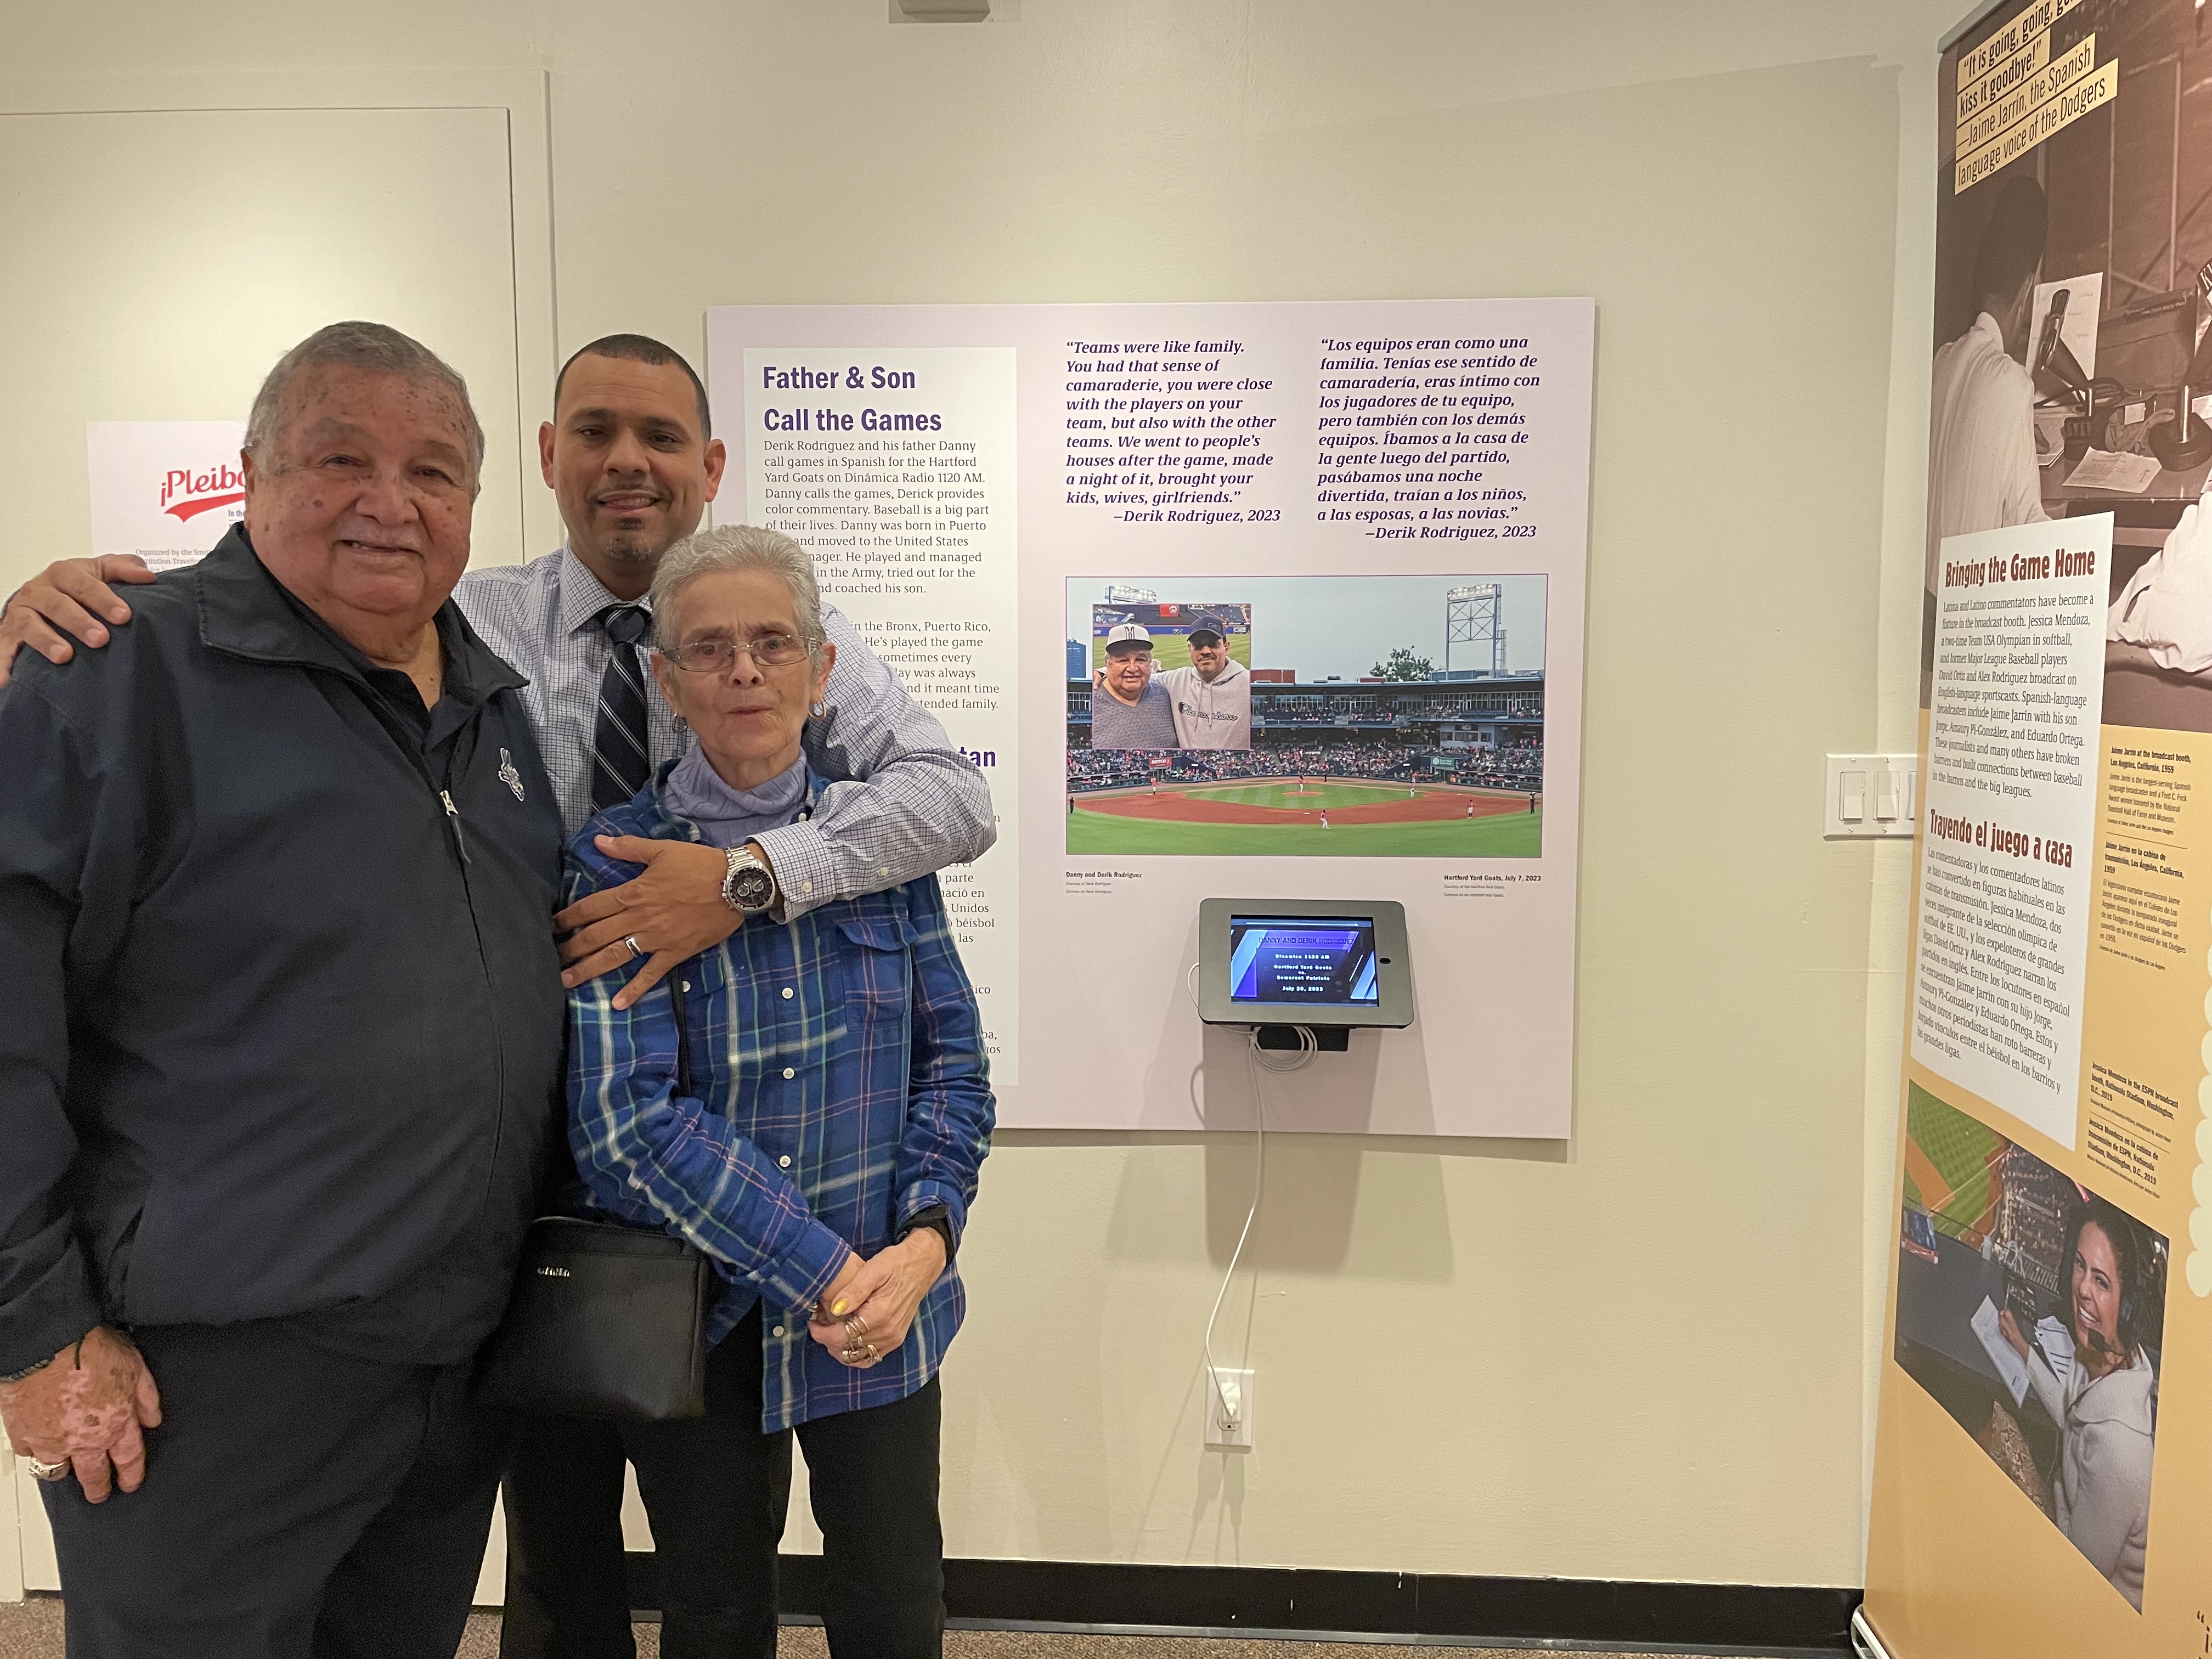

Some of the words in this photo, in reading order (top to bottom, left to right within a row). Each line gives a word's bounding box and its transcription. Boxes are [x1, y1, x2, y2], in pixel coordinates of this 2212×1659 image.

[1965, 55, 1977, 78] “It
[1978, 49, 1985, 70] is
[1989, 27, 2019, 66] going,
[2023, 1, 2053, 43] going,
[1960, 92, 1977, 117] kiss
[1981, 82, 1987, 103] it
[1990, 40, 2041, 101] goodbye!”
[1999, 91, 2027, 128] Jarrín,
[2030, 78, 2045, 105] the
[2049, 43, 2091, 93] Spanish
[1957, 146, 2001, 187] language
[2004, 129, 2026, 158] voice
[2029, 121, 2039, 141] of
[2041, 106, 2057, 133] the
[2061, 77, 2105, 120] Dodgers
[1066, 341, 1120, 353] “Teams
[1123, 343, 1160, 353] were
[1162, 340, 1190, 353] like
[1193, 339, 1244, 356] family.
[1321, 338, 1352, 351] “Los
[1355, 337, 1413, 354] equipos
[1415, 339, 1451, 350] eran
[1454, 338, 1495, 349] como
[1499, 338, 1528, 348] una
[1066, 360, 1092, 373] You
[1095, 359, 1125, 372] had
[1128, 359, 1159, 372] that
[1161, 362, 1201, 372] sense
[1204, 358, 1221, 371] of
[1319, 357, 1378, 370] familia.
[1383, 356, 1431, 369] Tenías
[1434, 358, 1458, 369] ese
[1460, 354, 1516, 368] sentido
[1519, 354, 1538, 367] de
[763, 365, 839, 389] Father
[845, 365, 865, 389] &
[870, 365, 915, 389] Son
[1065, 378, 1162, 393] camaraderie,
[1166, 381, 1193, 394] you
[1197, 380, 1233, 391] were
[1236, 377, 1273, 390] close
[1319, 375, 1420, 390] camaradería,
[1424, 377, 1456, 388] eras
[1458, 374, 1510, 387] íntimo
[1513, 376, 1540, 386] con
[763, 408, 809, 431] Call
[815, 408, 854, 431] the
[860, 408, 942, 431] Games
[763, 439, 794, 450] Derik
[797, 439, 855, 453] Rodriguez
[857, 439, 879, 451] and
[882, 440, 899, 451] his
[902, 439, 936, 451] father
[938, 440, 976, 454] Danny
[764, 455, 784, 466] call
[787, 458, 824, 469] games
[827, 455, 839, 466] in
[840, 456, 885, 469] Spanish
[888, 455, 905, 466] for
[907, 456, 926, 467] the
[928, 455, 977, 467] Hartford
[764, 472, 789, 482] Yard
[792, 472, 824, 483] Goats
[826, 474, 842, 483] on
[844, 472, 899, 483] Dinámica
[901, 472, 934, 483] Radio
[936, 472, 961, 483] 1120
[963, 472, 985, 483] AM.
[1166, 509, 1243, 524] Rodriguez,
[1246, 509, 1281, 521] 2023
[1419, 525, 1498, 541] Rodriguez,
[1501, 524, 1537, 538] 2023
[1945, 559, 1986, 588] Bringing
[1988, 556, 2007, 584] the
[2010, 554, 2050, 582] Game
[2055, 549, 2095, 578] Home
[1991, 670, 2028, 686] Rodríguez
[2162, 765, 2174, 773] 1959
[1930, 809, 1972, 844] Trayendo
[1975, 821, 1988, 848] el
[1990, 822, 2029, 858] juego
[2033, 836, 2041, 860] a
[2045, 839, 2073, 868] casa
[1113, 871, 1142, 879] Rodriguez
[2102, 1090, 2113, 1102] 2019
